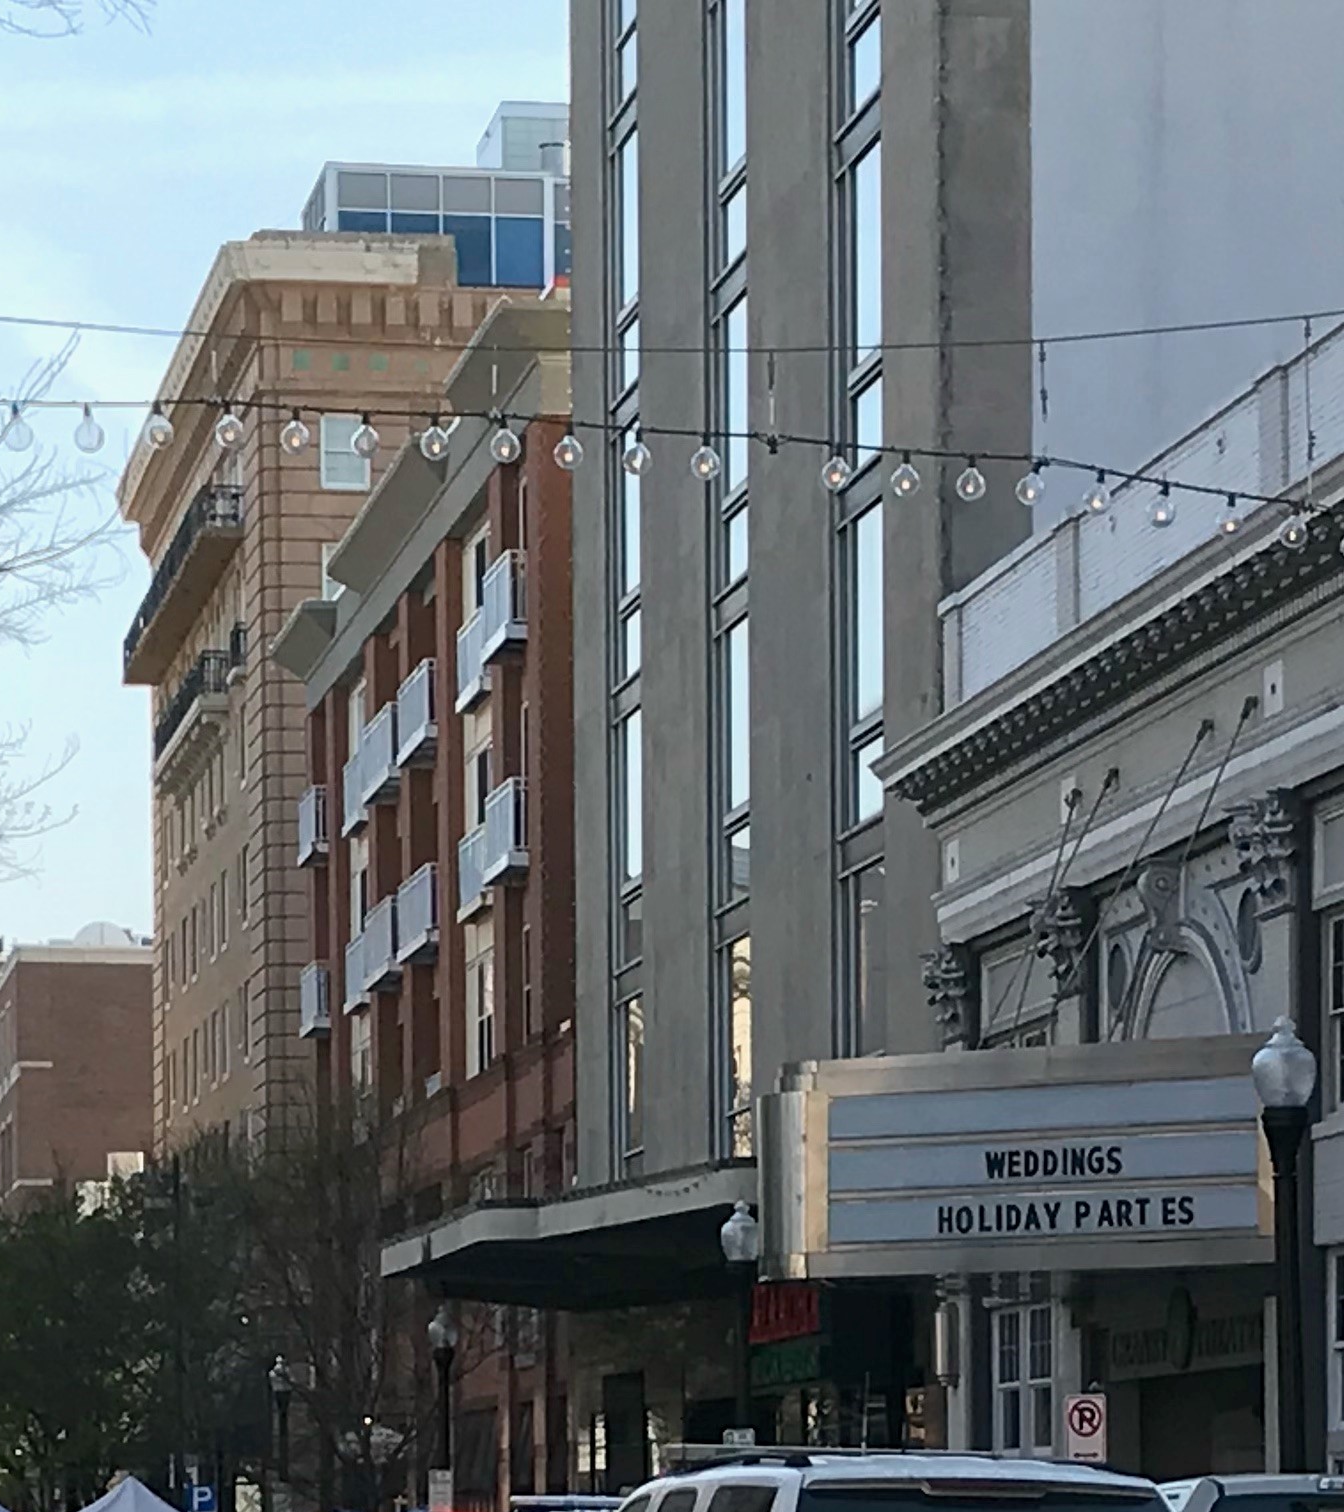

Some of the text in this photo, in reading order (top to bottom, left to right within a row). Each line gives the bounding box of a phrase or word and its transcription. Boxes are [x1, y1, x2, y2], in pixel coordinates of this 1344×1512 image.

[984, 1145, 1124, 1179] WEDDINGS
[937, 1200, 1061, 1235] HOLIDAY
[192, 1485, 212, 1511] P
